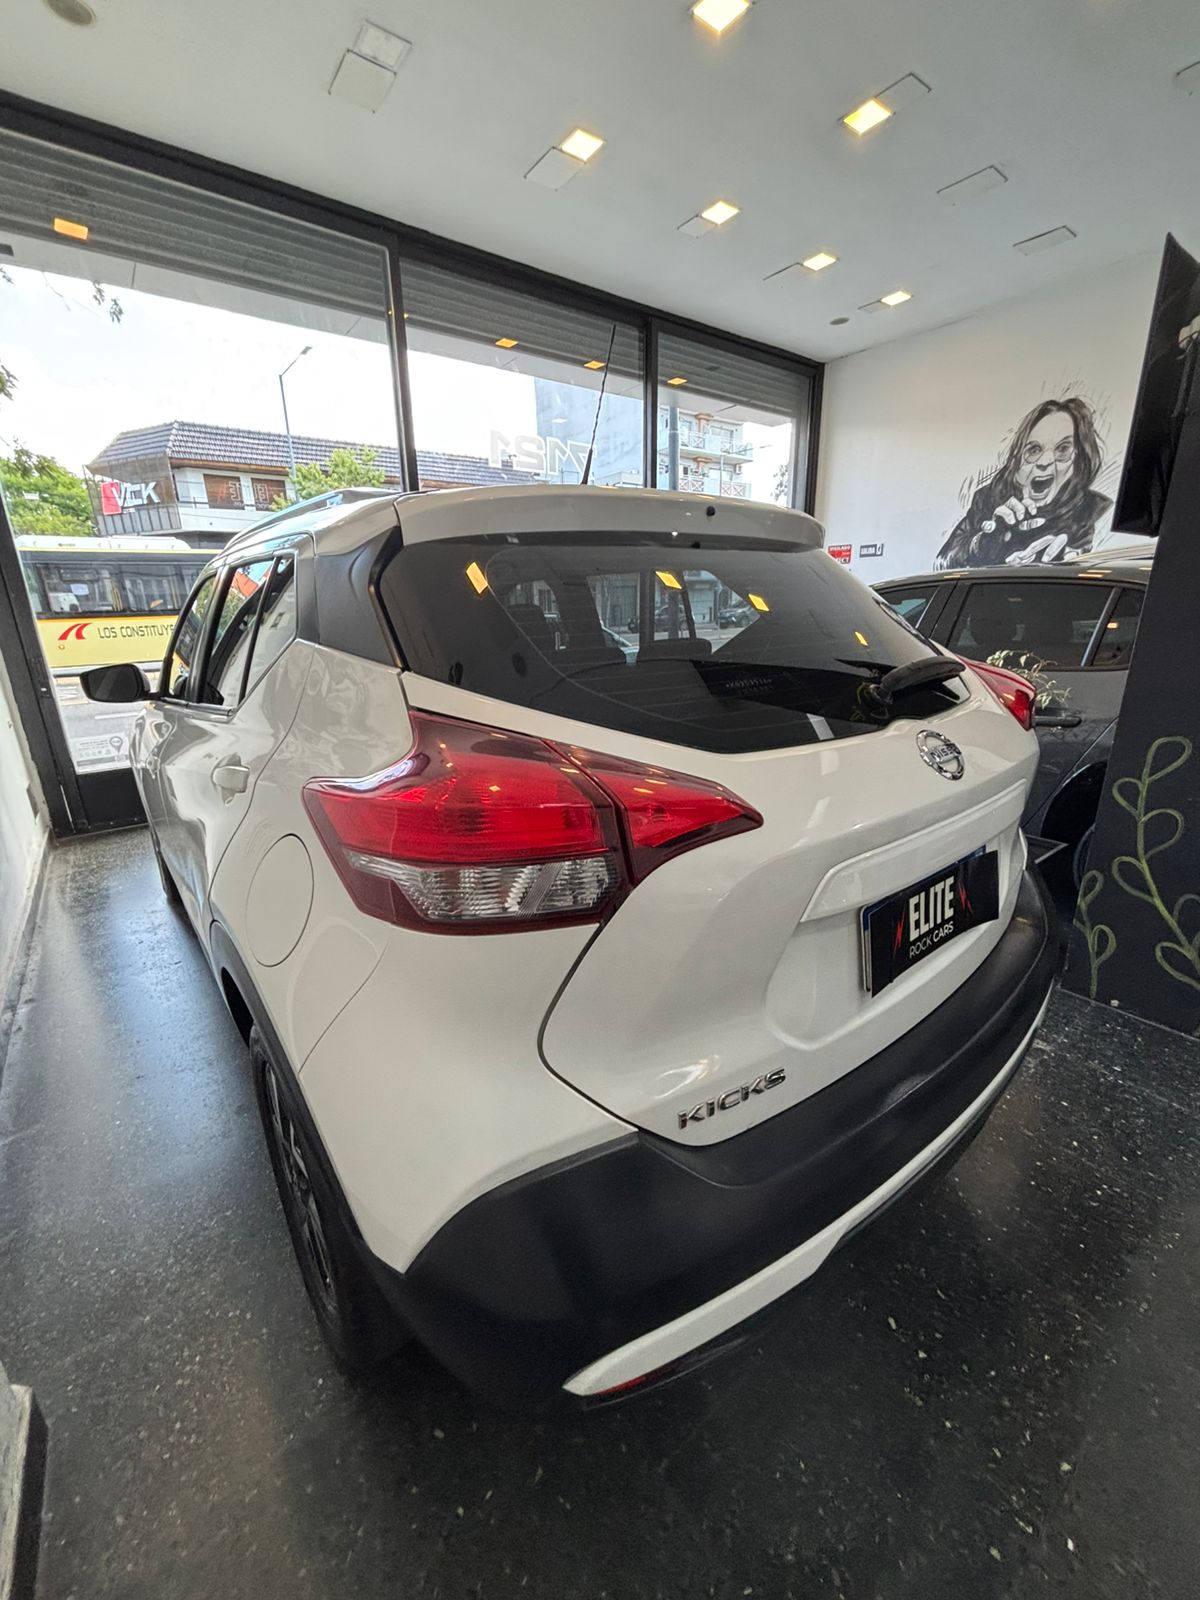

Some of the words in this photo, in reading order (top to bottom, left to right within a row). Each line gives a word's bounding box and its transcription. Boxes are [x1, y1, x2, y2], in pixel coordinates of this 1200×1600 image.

[97, 626, 118, 639] LOS
[908, 875, 954, 942] ELITE
[909, 934, 932, 959] ROCK
[932, 920, 954, 942] CARS
[677, 1066, 786, 1130] KICKS
